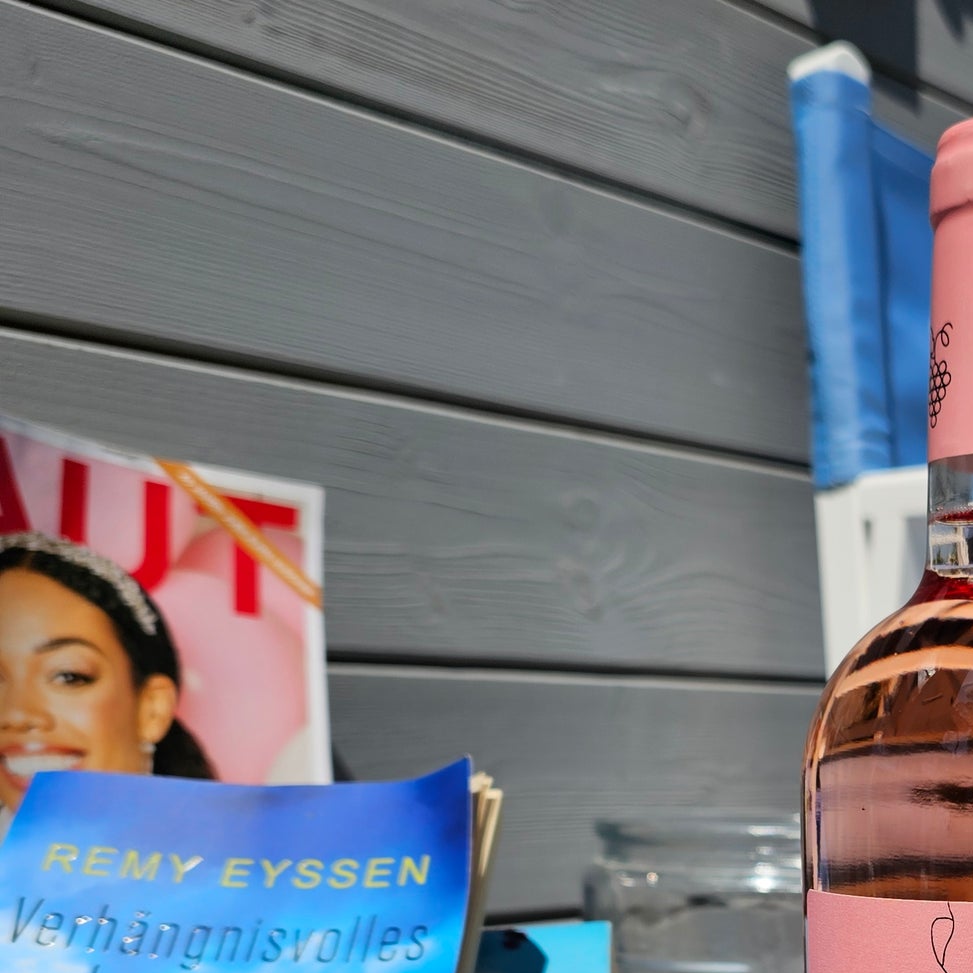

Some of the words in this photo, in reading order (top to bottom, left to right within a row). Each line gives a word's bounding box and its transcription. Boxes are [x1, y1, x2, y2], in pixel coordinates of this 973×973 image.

[42, 843, 204, 883] REMY
[220, 855, 431, 889] EYSSEN
[11, 896, 429, 970] Verhängnisvolles
